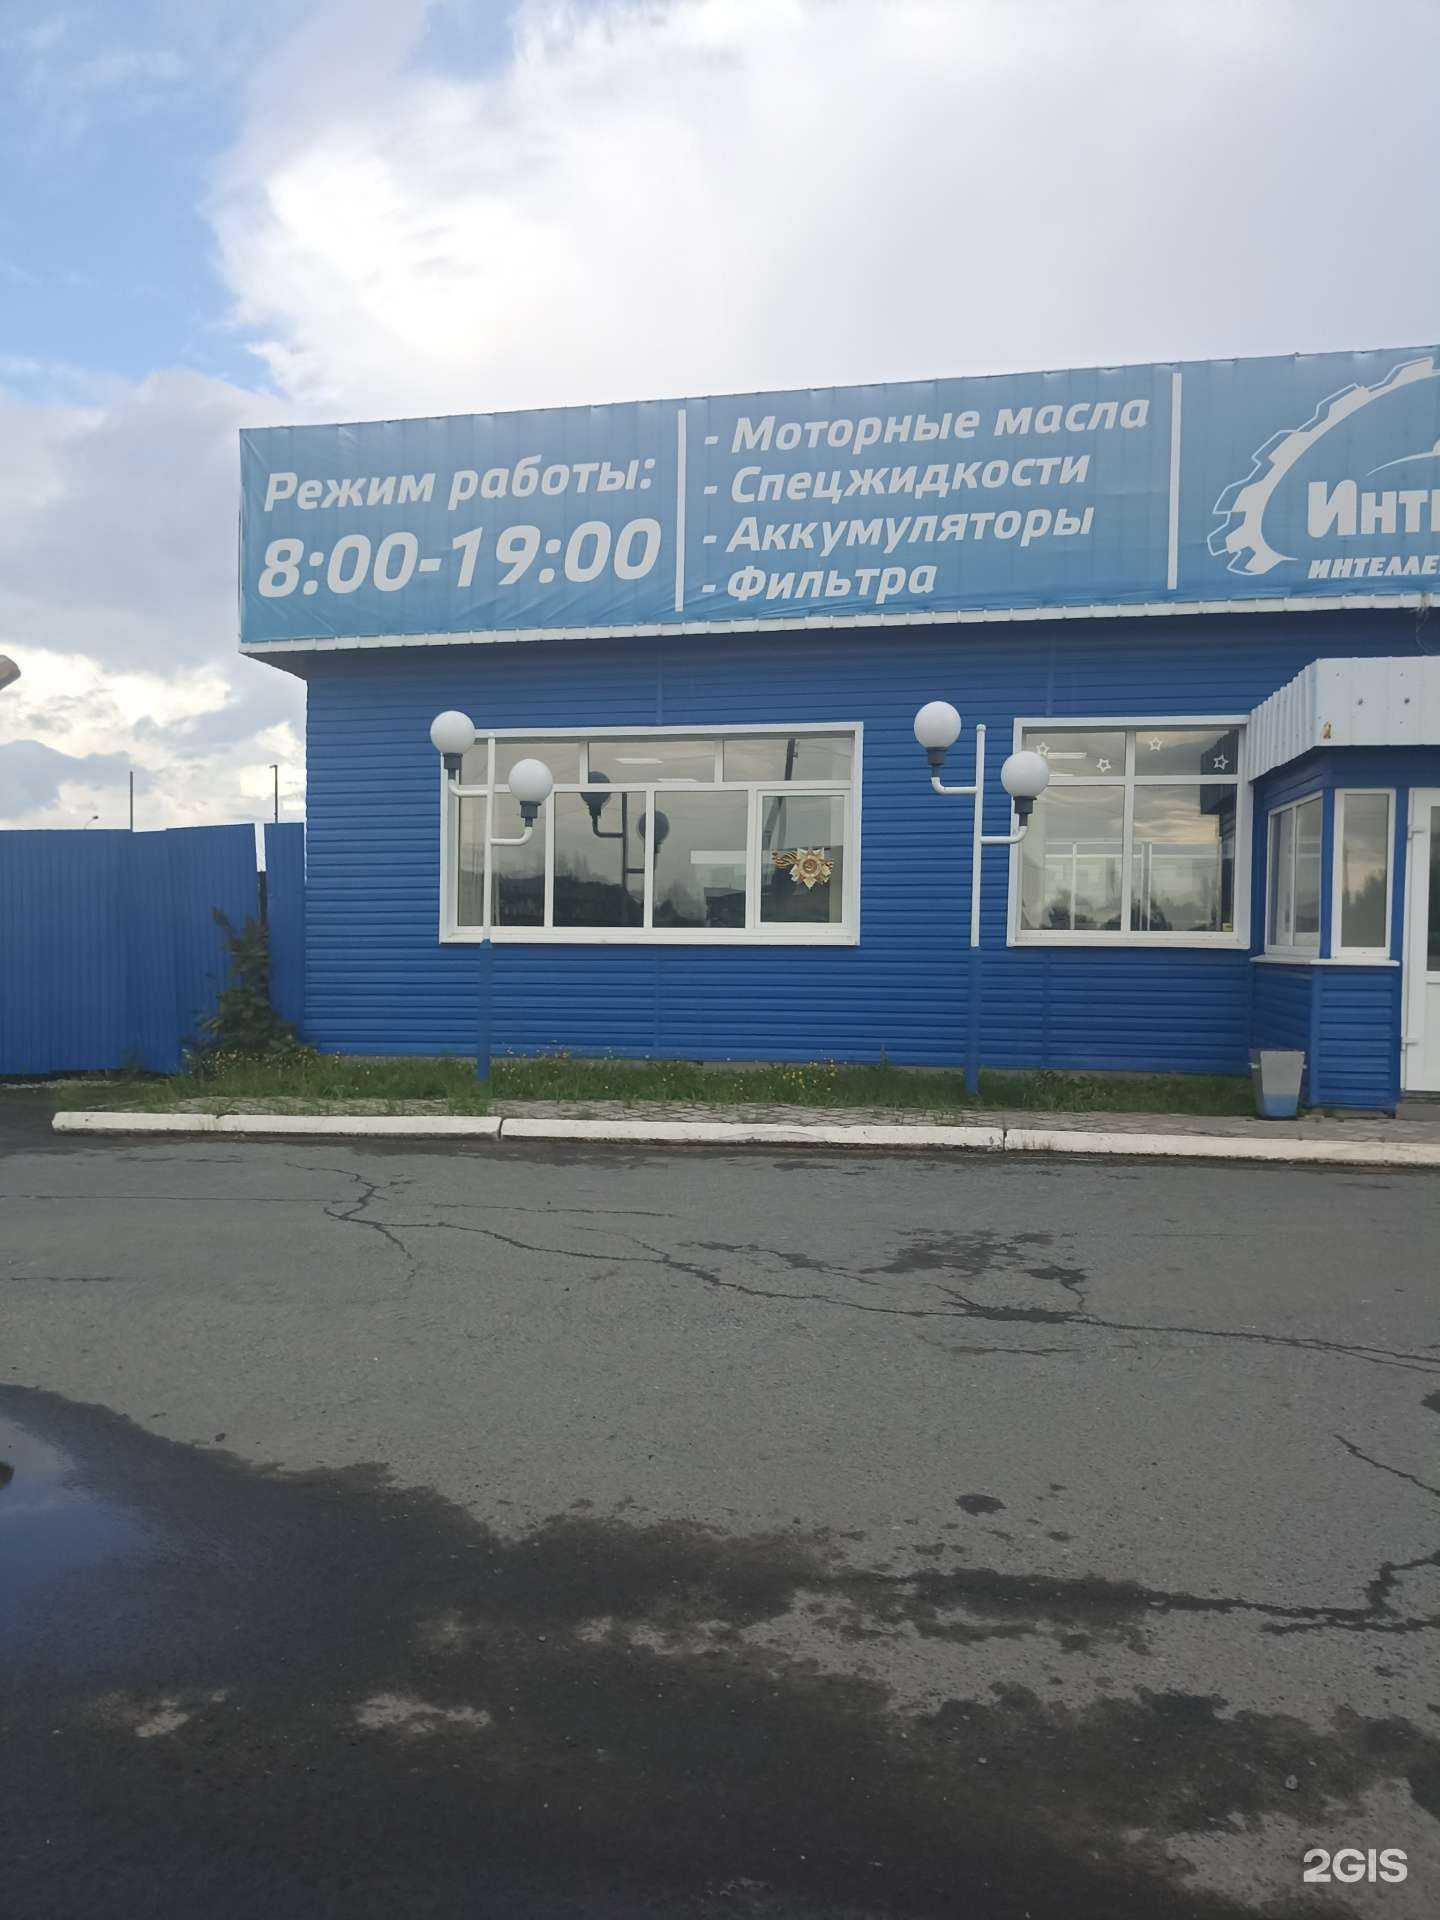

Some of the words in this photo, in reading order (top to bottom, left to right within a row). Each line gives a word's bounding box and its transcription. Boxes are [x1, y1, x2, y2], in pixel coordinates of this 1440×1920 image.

[732, 409, 980, 455] Моторные
[994, 398, 1150, 436] масла
[264, 472, 435, 512] Режим
[448, 455, 656, 511] работы:
[731, 453, 1090, 504] Спецжидкости
[726, 506, 1094, 557] Аккумуляторы
[258, 518, 662, 598] 8:00-19:00
[1307, 555, 1440, 579] ИНТЕЛЛЕ
[727, 564, 938, 604] Фильтра
